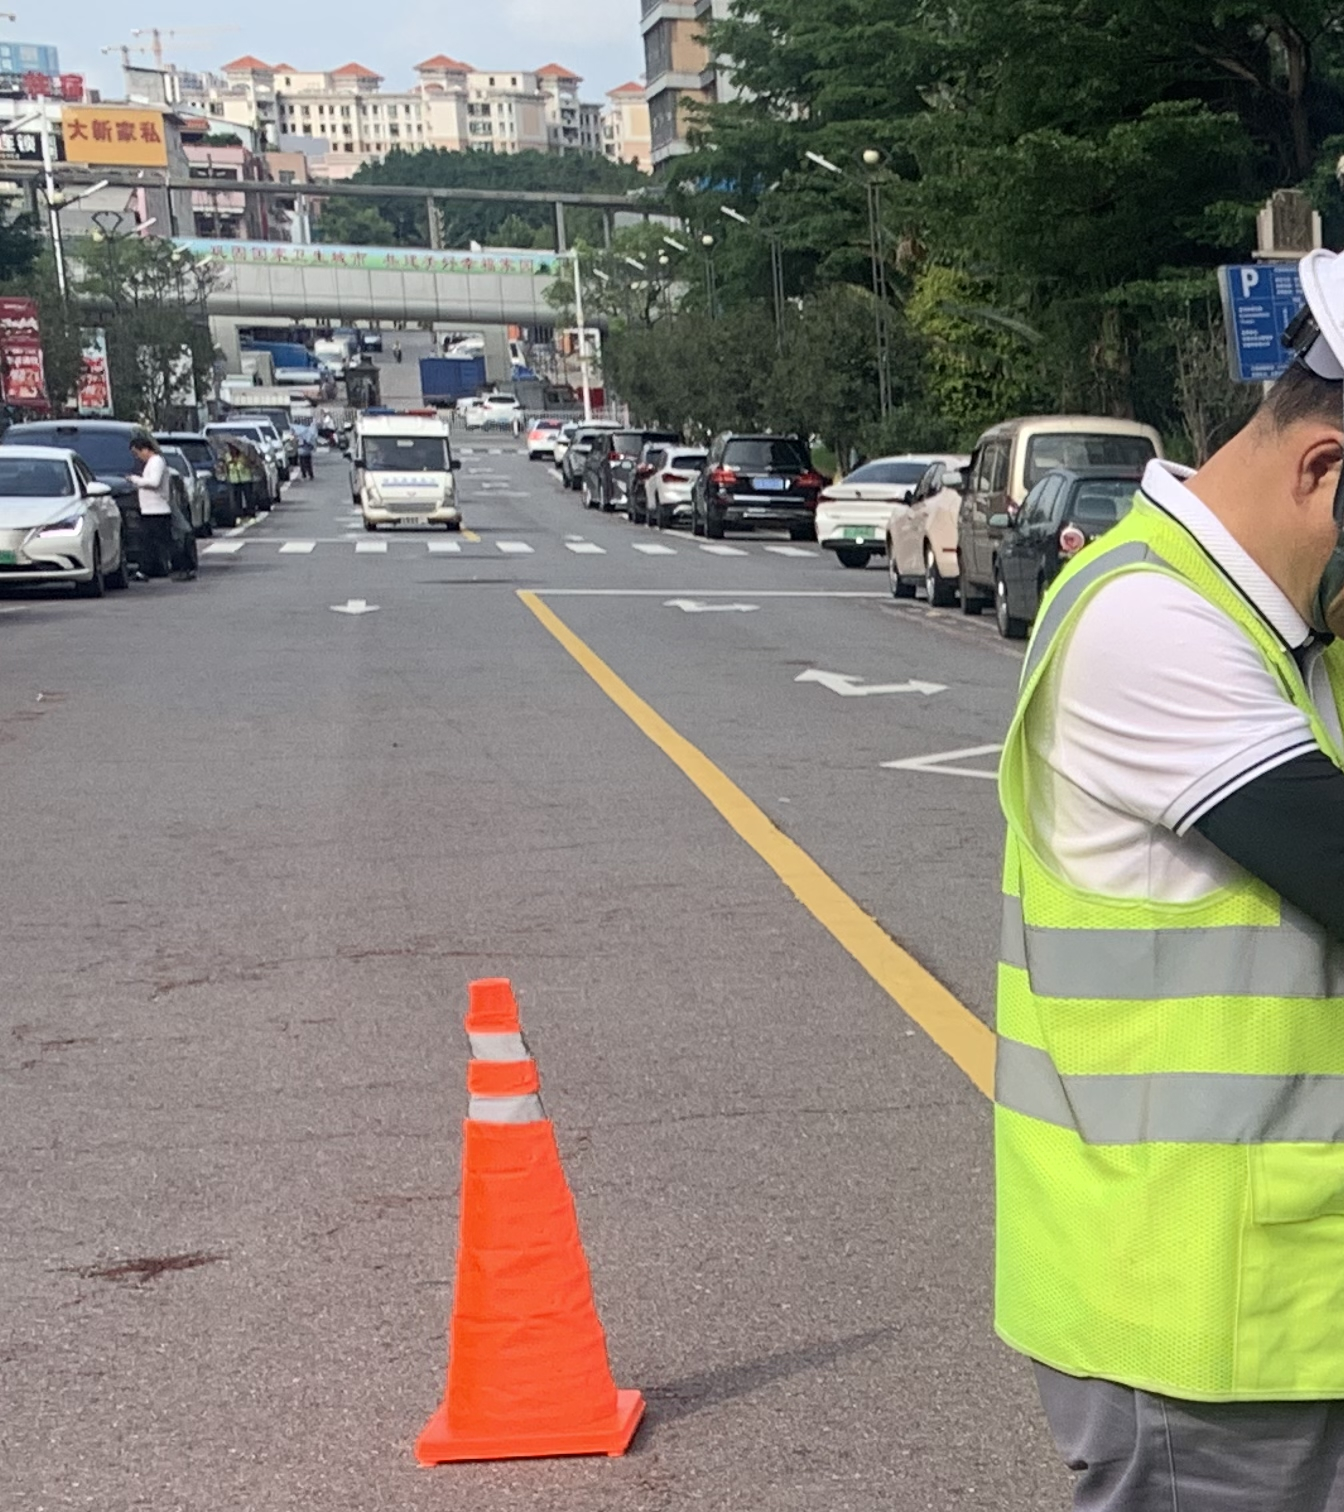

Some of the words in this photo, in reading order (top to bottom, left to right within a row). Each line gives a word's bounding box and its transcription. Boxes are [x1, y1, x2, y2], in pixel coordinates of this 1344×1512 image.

[68, 119, 161, 143] 大新家私
[1241, 268, 1259, 298] P
